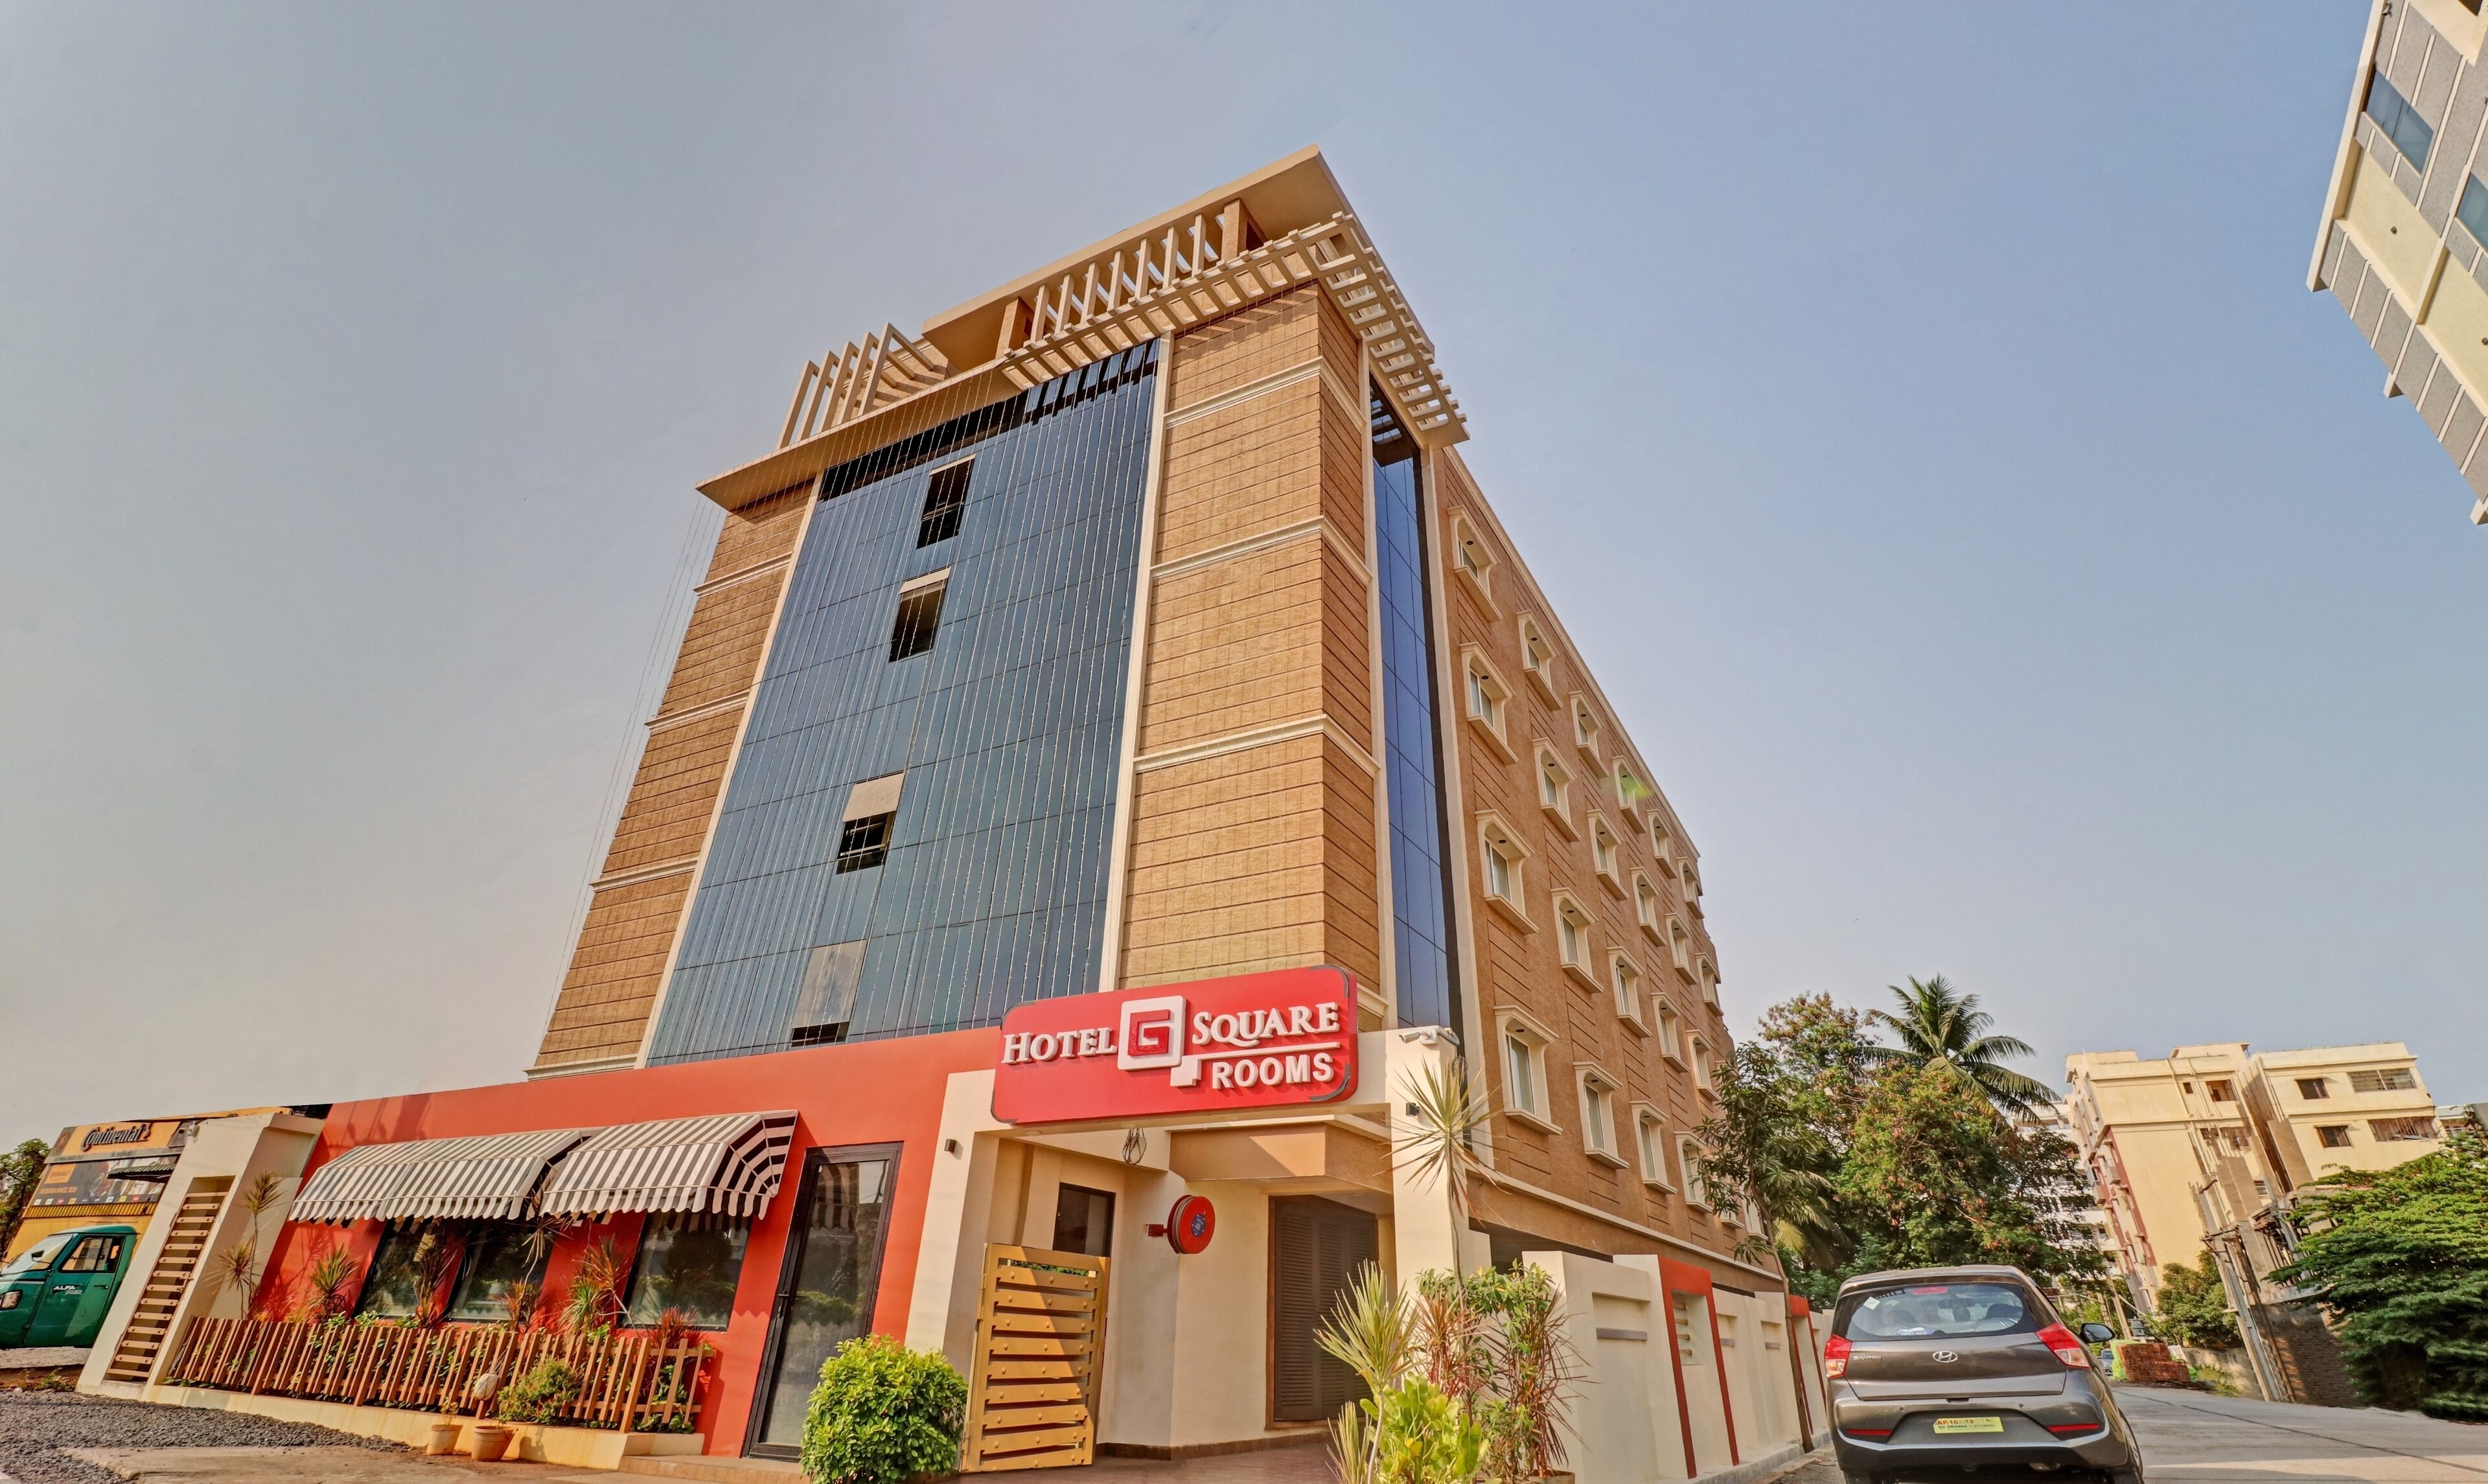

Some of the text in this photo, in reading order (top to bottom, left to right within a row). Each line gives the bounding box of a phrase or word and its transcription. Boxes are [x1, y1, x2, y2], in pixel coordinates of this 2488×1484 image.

[1001, 1027, 1118, 1064] HOTEL
[1192, 1002, 1340, 1047] SQUARE
[1212, 1053, 1334, 1090] ROOMS
[81, 1124, 146, 1152] Continental
